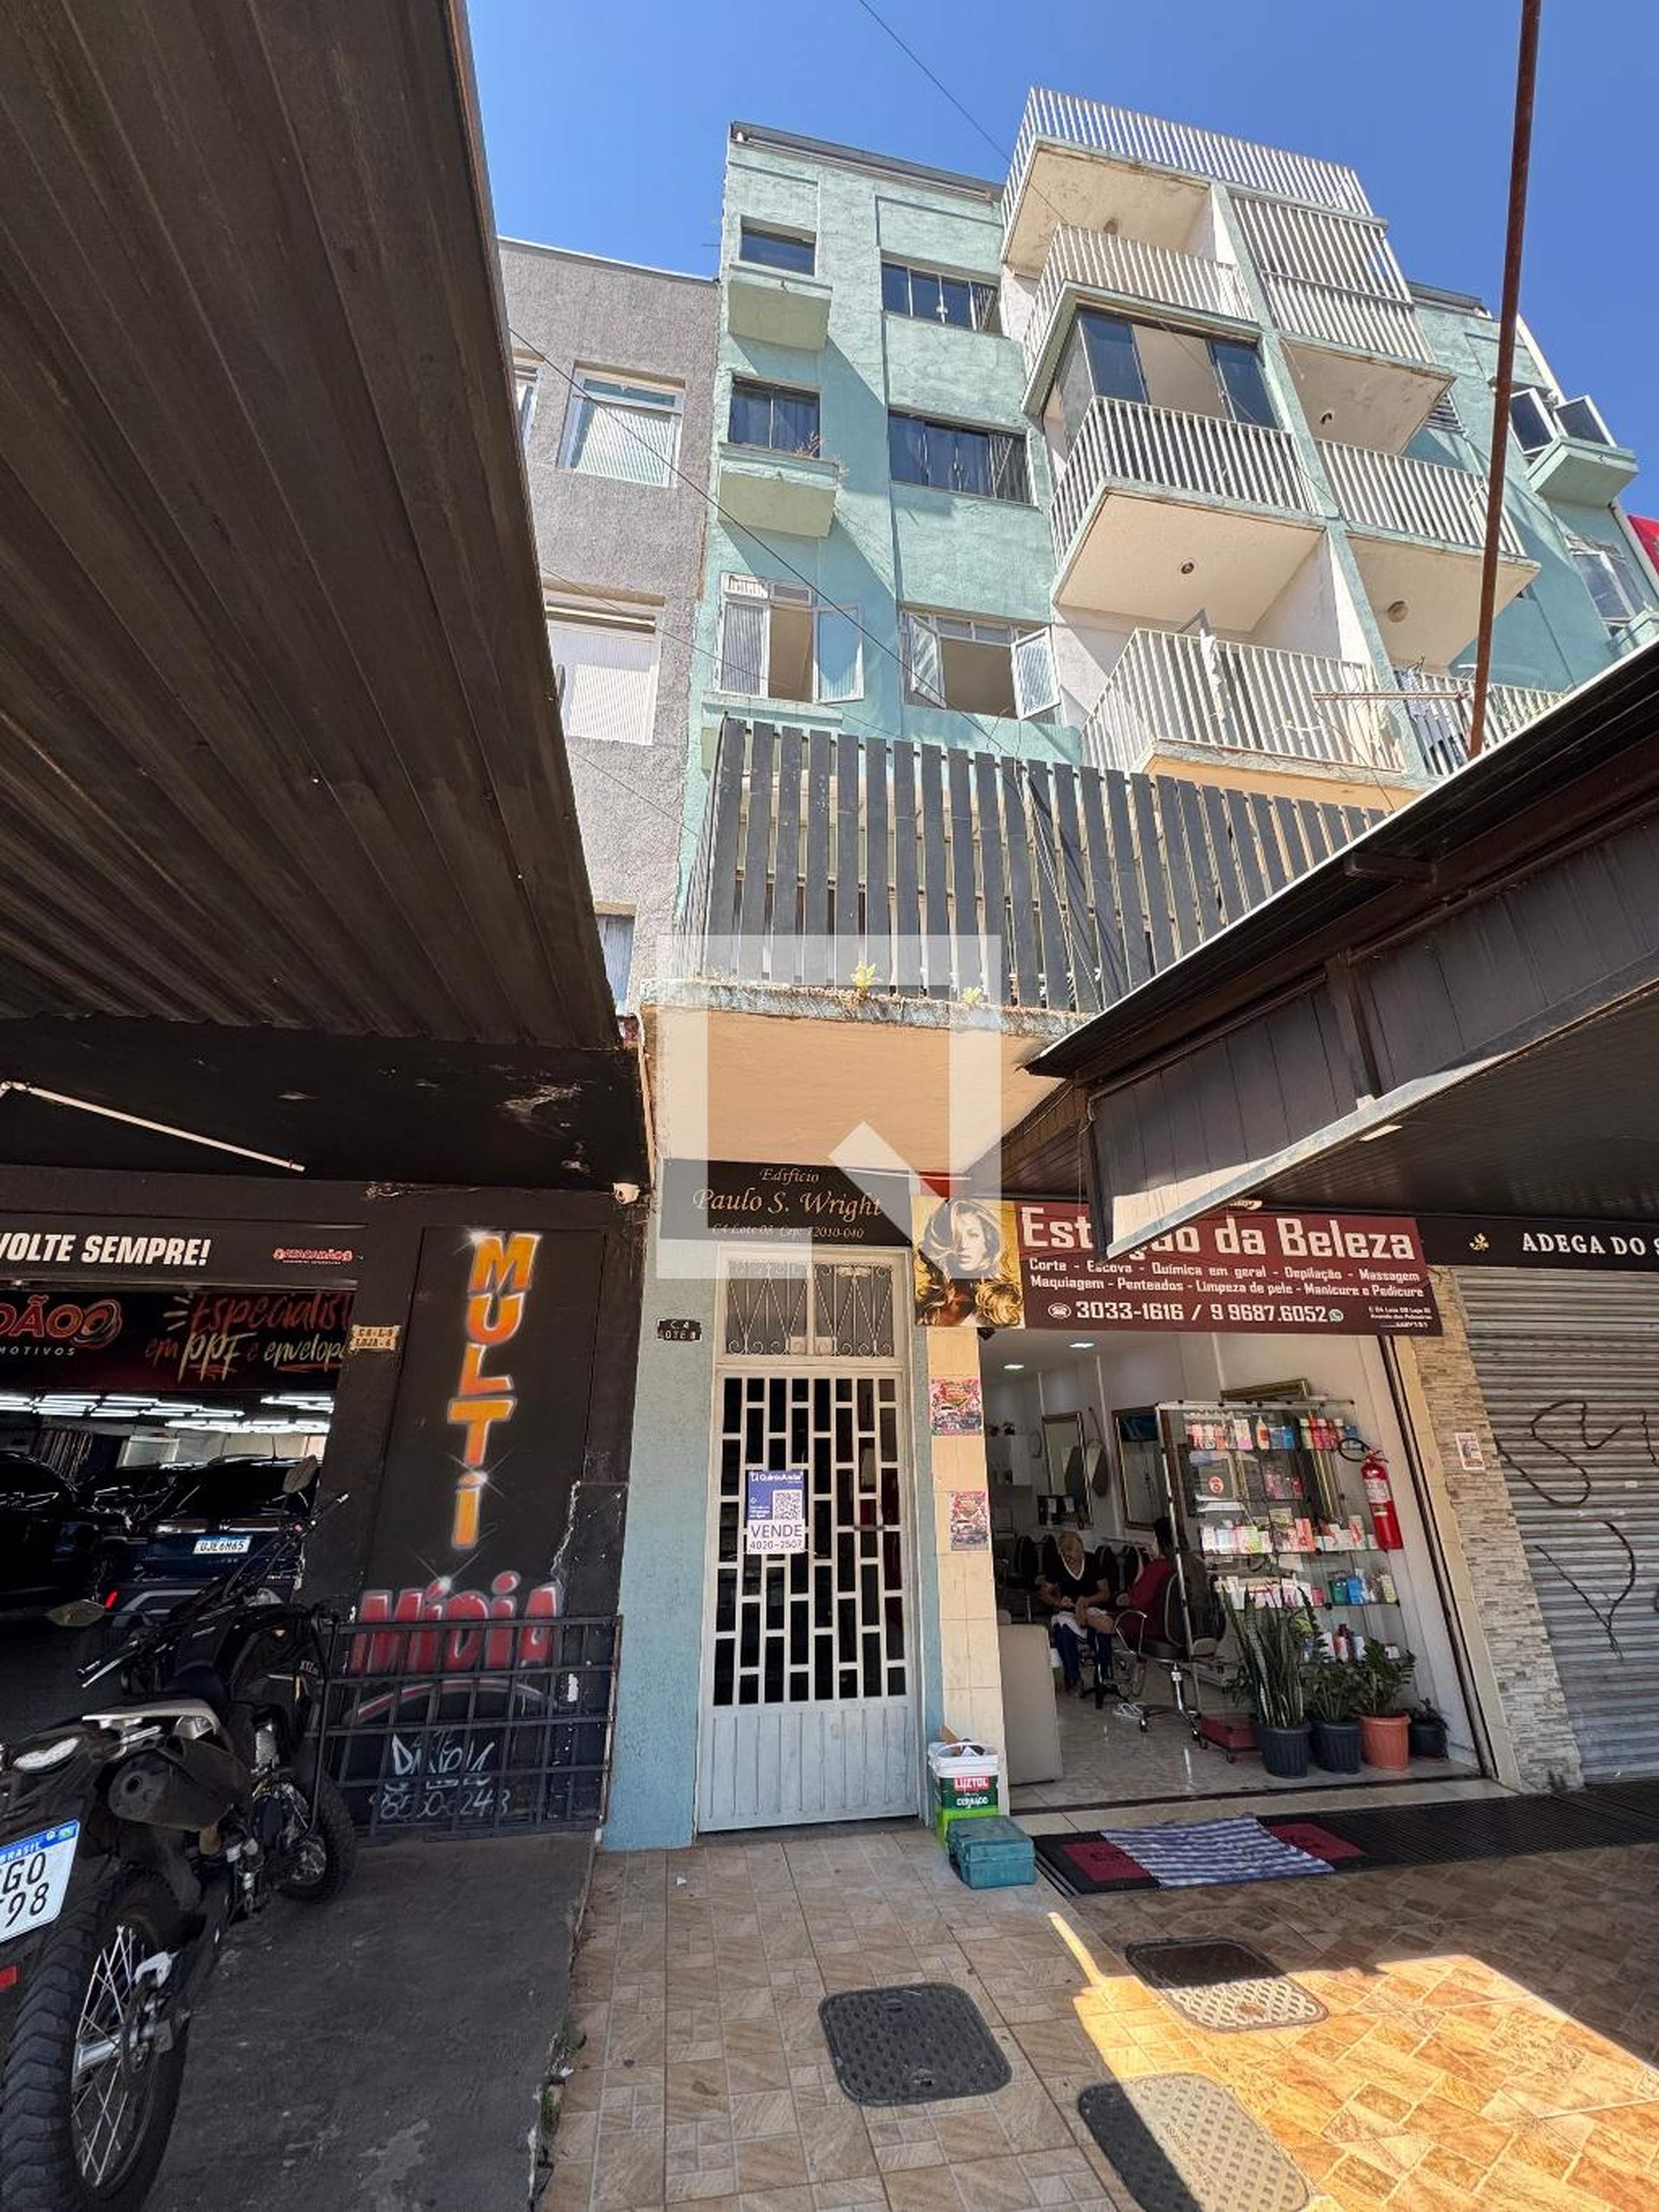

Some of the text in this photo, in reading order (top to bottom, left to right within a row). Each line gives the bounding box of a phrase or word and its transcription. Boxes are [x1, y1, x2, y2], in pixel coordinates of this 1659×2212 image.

[693, 1187, 883, 1222] Paulo S. Wright
[1215, 1215, 1266, 1255] da
[1276, 1218, 1416, 1260] Beleza
[1522, 1232, 1606, 1254] ADEGA
[1611, 1237, 1646, 1256] DO
[81, 1235, 211, 1266] SEMPRE!
[1029, 1258, 1067, 1272] Corte
[1152, 1261, 1202, 1276] Química
[1210, 1267, 1227, 1276] em
[1234, 1265, 1266, 1279] geral
[1284, 1267, 1342, 1280] Depilação
[1359, 1268, 1420, 1283] Massagem
[1031, 1275, 1104, 1291] Maquiagem
[1117, 1278, 1183, 1291] Penteados
[1196, 1280, 1246, 1295] Limpeza
[1250, 1282, 1265, 1293] de
[1268, 1283, 1292, 1296] pele
[1304, 1283, 1360, 1296] Manicure
[1372, 1285, 1424, 1297] Pedicure
[1075, 1301, 1185, 1321] 3033-1616
[750, 1524, 803, 1538] VENDE
[0, 1852, 46, 1895] GO
